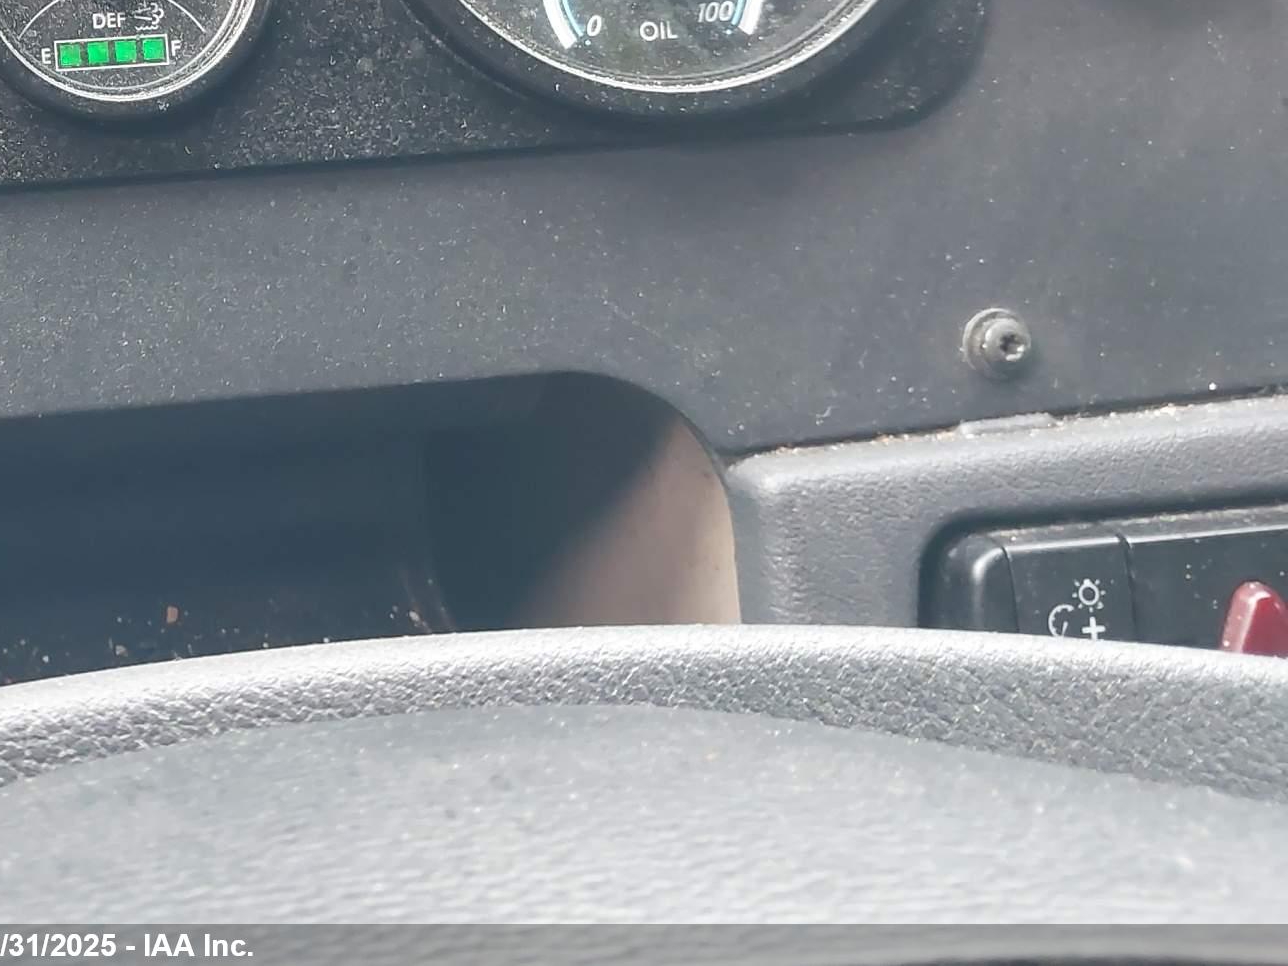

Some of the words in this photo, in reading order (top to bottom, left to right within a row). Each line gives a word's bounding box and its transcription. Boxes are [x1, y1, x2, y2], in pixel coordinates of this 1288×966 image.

[697, 1, 734, 23] 100
[92, 13, 126, 30] DEF
[587, 15, 602, 36] 0
[639, 22, 679, 42] OIL
[41, 48, 51, 64] E
[170, 41, 182, 56] F
